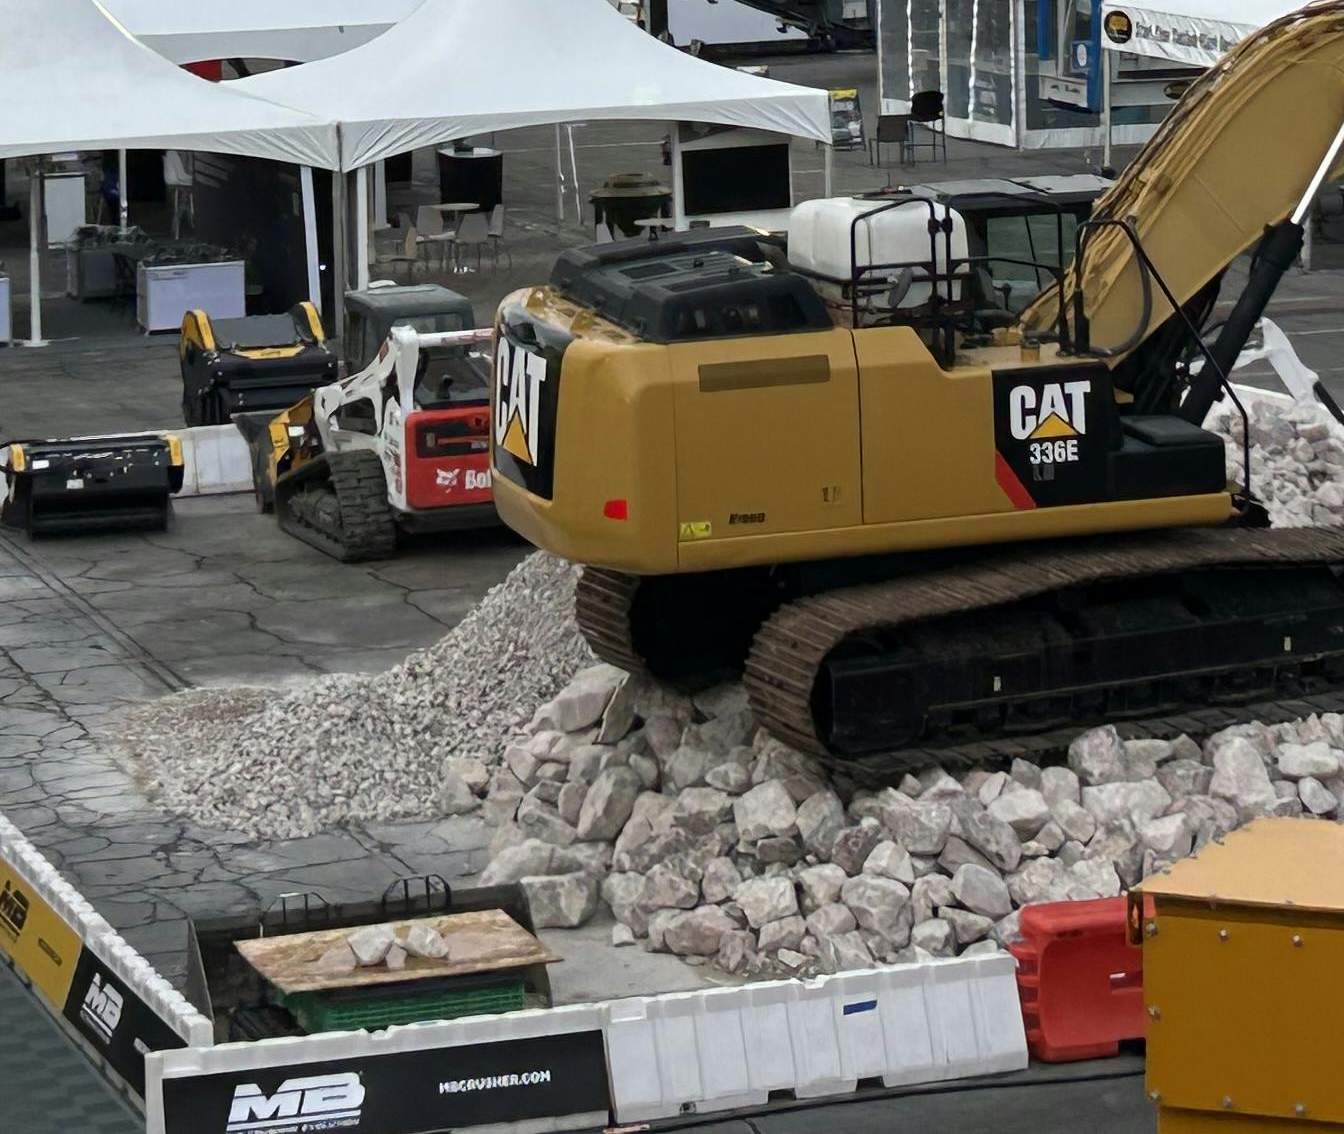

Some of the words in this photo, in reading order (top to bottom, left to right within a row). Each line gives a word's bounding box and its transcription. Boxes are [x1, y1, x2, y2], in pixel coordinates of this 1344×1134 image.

[495, 337, 547, 466] CAT
[1010, 380, 1091, 440] CAT
[1030, 439, 1079, 464] 336E
[85, 972, 124, 1029] MB
[227, 1072, 366, 1124] MB
